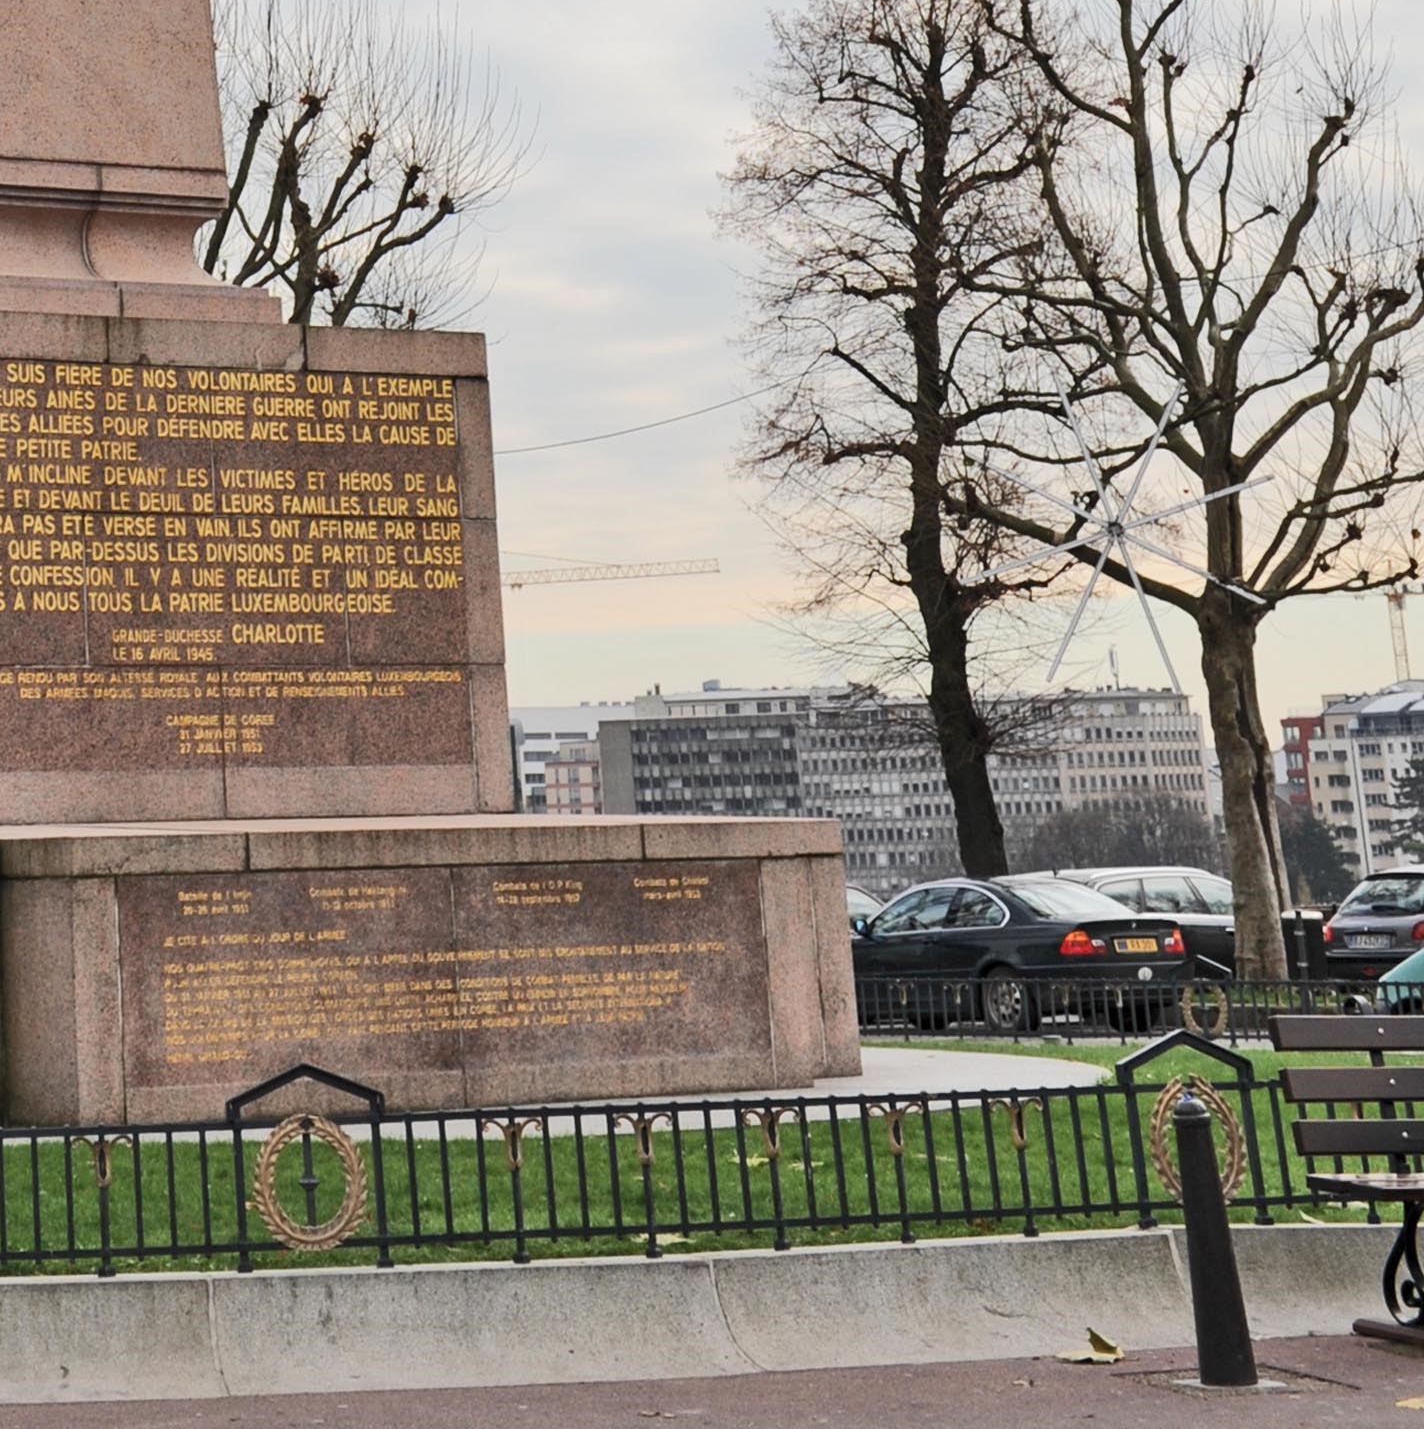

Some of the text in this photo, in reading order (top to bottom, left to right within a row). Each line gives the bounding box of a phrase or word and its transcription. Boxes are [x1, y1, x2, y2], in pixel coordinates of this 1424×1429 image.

[5, 365, 46, 384] SUIS
[109, 369, 134, 387] DE
[140, 370, 177, 389] NOS
[187, 372, 297, 393] VOLONTAIRES
[103, 393, 126, 410] DE
[135, 394, 158, 411] LA
[321, 399, 351, 417] ONT
[357, 400, 419, 419] REJOINT
[426, 402, 454, 420] LES
[27, 411, 94, 435] ALLIÉES
[102, 418, 148, 437] POUR
[156, 415, 244, 439] DÉFENDRE
[249, 422, 289, 440] AVEC
[295, 423, 346, 442] ELLES
[351, 425, 373, 443] LA
[378, 425, 429, 444] CAUSE
[434, 427, 456, 445] DE
[14, 439, 71, 459] PETITE
[80, 441, 142, 461] PATRIE.
[102, 468, 167, 486] DEVANT
[175, 469, 209, 487] LES
[219, 470, 296, 489] VICTIMES
[305, 472, 326, 489] ET
[337, 469, 393, 491] HÉROS
[403, 475, 425, 491] DE
[434, 475, 457, 492] LA
[12, 491, 31, 508] ET
[38, 492, 103, 509] DEVANT
[109, 493, 129, 510] LE
[138, 494, 185, 511] DEUIL
[191, 495, 213, 511] DE
[221, 495, 275, 513] LEURS
[281, 496, 363, 514] FAMILLES.
[368, 498, 409, 515] LEUR
[415, 499, 458, 516] SANG
[21, 517, 56, 534] PAS
[162, 519, 187, 536] EN
[236, 520, 263, 537] ILS
[268, 521, 300, 538] ONT
[383, 522, 416, 540] PAR
[423, 523, 461, 540] LEUR
[7, 542, 42, 559] QUE
[48, 542, 160, 561] PAR-DESSUS
[167, 544, 200, 561] LES
[204, 544, 286, 562] DIVISIONS
[290, 545, 313, 562] DE
[374, 546, 396, 563] DE
[402, 546, 462, 564] CLASSE
[123, 568, 140, 586] IL
[149, 569, 161, 586] Y
[169, 569, 183, 586] A
[190, 569, 225, 587] UNE
[234, 564, 301, 587] RÉALITÉ
[310, 570, 331, 587] ET
[346, 570, 369, 588] UN
[373, 566, 418, 588] IDÉAL
[423, 571, 463, 588] COM-
[31, 593, 80, 611] NOUS
[140, 594, 162, 612] LA
[168, 595, 223, 612] PATRIE
[231, 595, 396, 613] LUXEMBOURGEOISE.
[111, 625, 324, 643] GRANDE-DUCHESSE CHARLOTTE
[113, 647, 217, 660] LE 16 AVRIL 1945.
